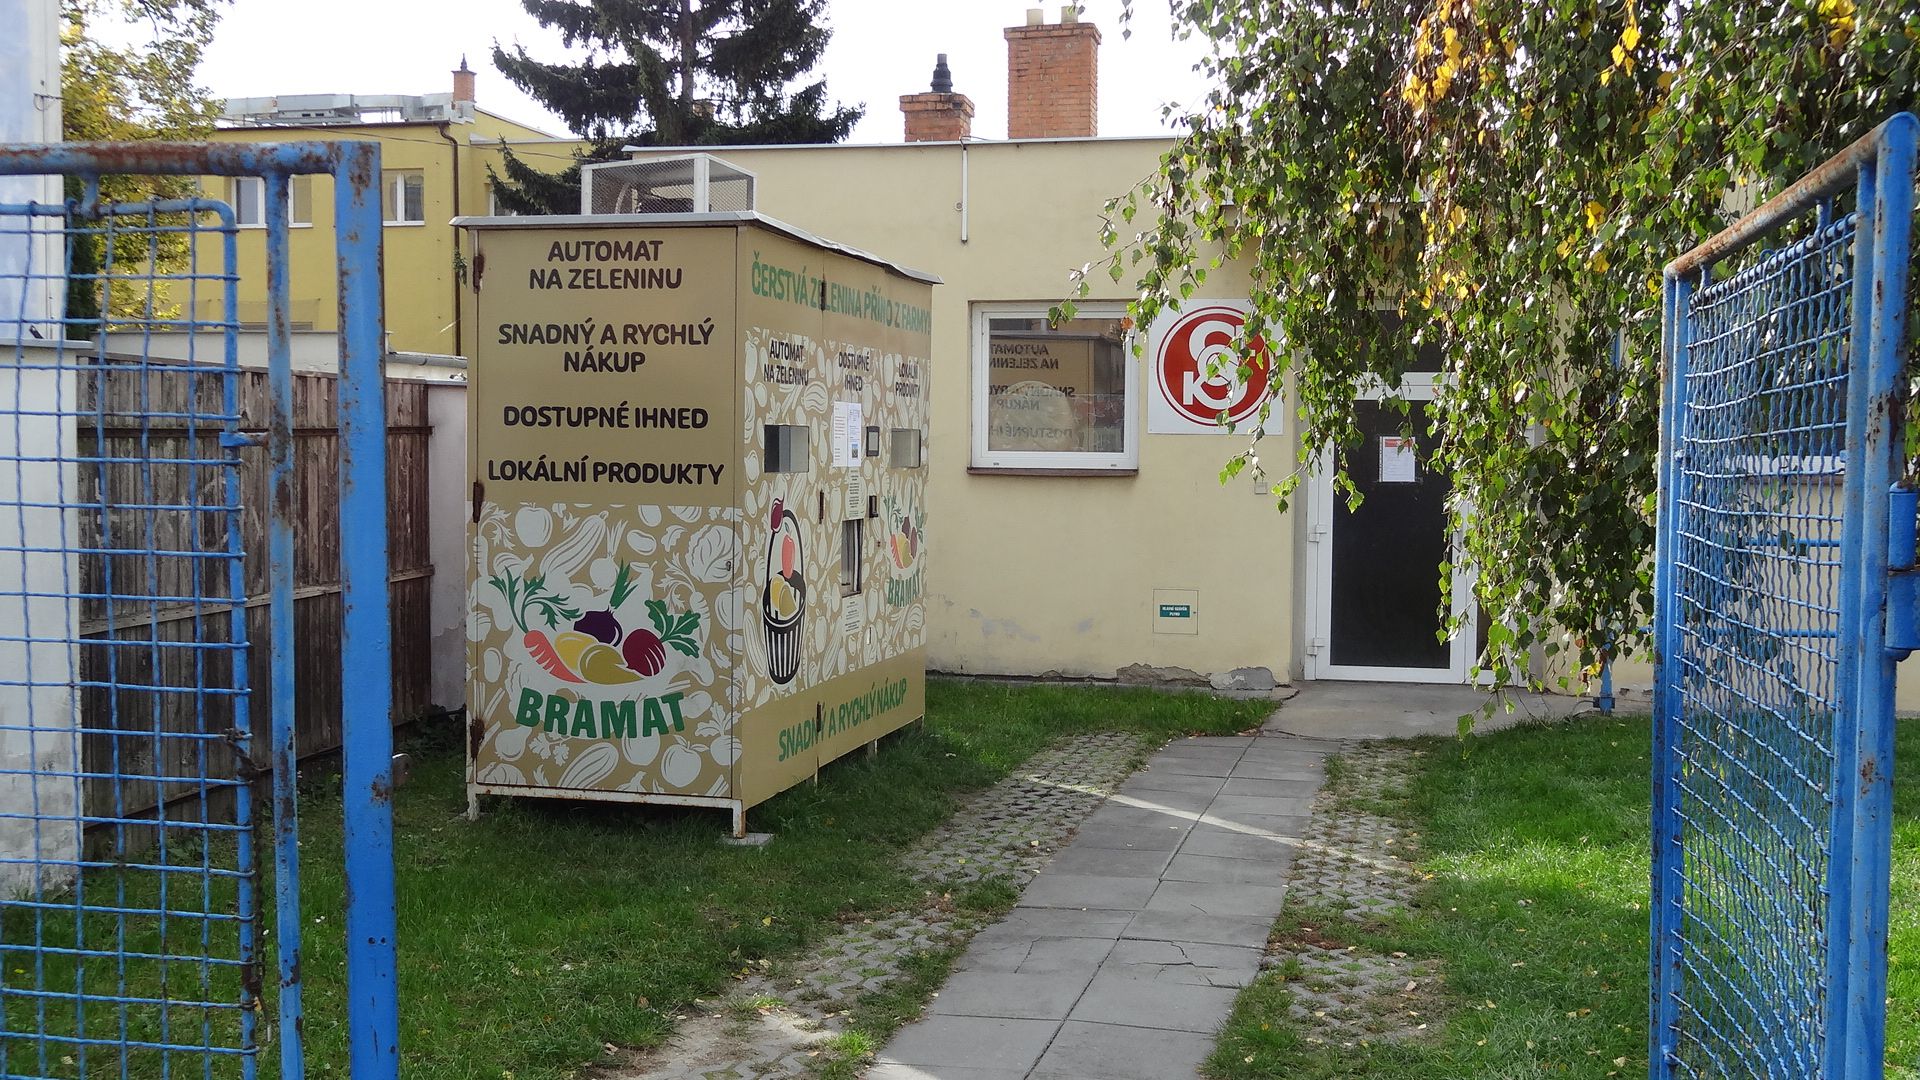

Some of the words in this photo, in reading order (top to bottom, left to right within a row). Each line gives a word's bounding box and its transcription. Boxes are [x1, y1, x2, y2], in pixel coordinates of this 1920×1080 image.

[547, 240, 664, 262] AUTOMAT
[529, 268, 563, 290] NA
[567, 268, 683, 290] ZELENINU
[751, 251, 808, 307] ČERSTVÁ
[863, 285, 893, 327] PŘÍMO
[894, 302, 901, 328] Z
[498, 317, 596, 345] SNADNÝ
[599, 323, 618, 345] A
[622, 317, 715, 346] RYCHLÝ
[563, 345, 646, 373] NÁKUP
[769, 340, 804, 362] AUTOMAT
[838, 351, 870, 372] DOSTUPNÉ
[763, 363, 775, 383] NA
[776, 365, 809, 387] ZELENINU
[844, 374, 863, 392] IHNED
[503, 400, 630, 428] DOSTUPNÉ
[634, 406, 709, 429] IHNED
[488, 455, 589, 482] LOKÁLNÍ
[593, 461, 725, 485] PRODUKTY
[888, 569, 921, 608] BRAMAT
[515, 687, 686, 739] BRAMAT
[778, 701, 827, 762] SNADNÝ
[828, 707, 837, 738] A
[838, 681, 877, 733] RYCHLÝ
[876, 677, 907, 717] NÁKUP
